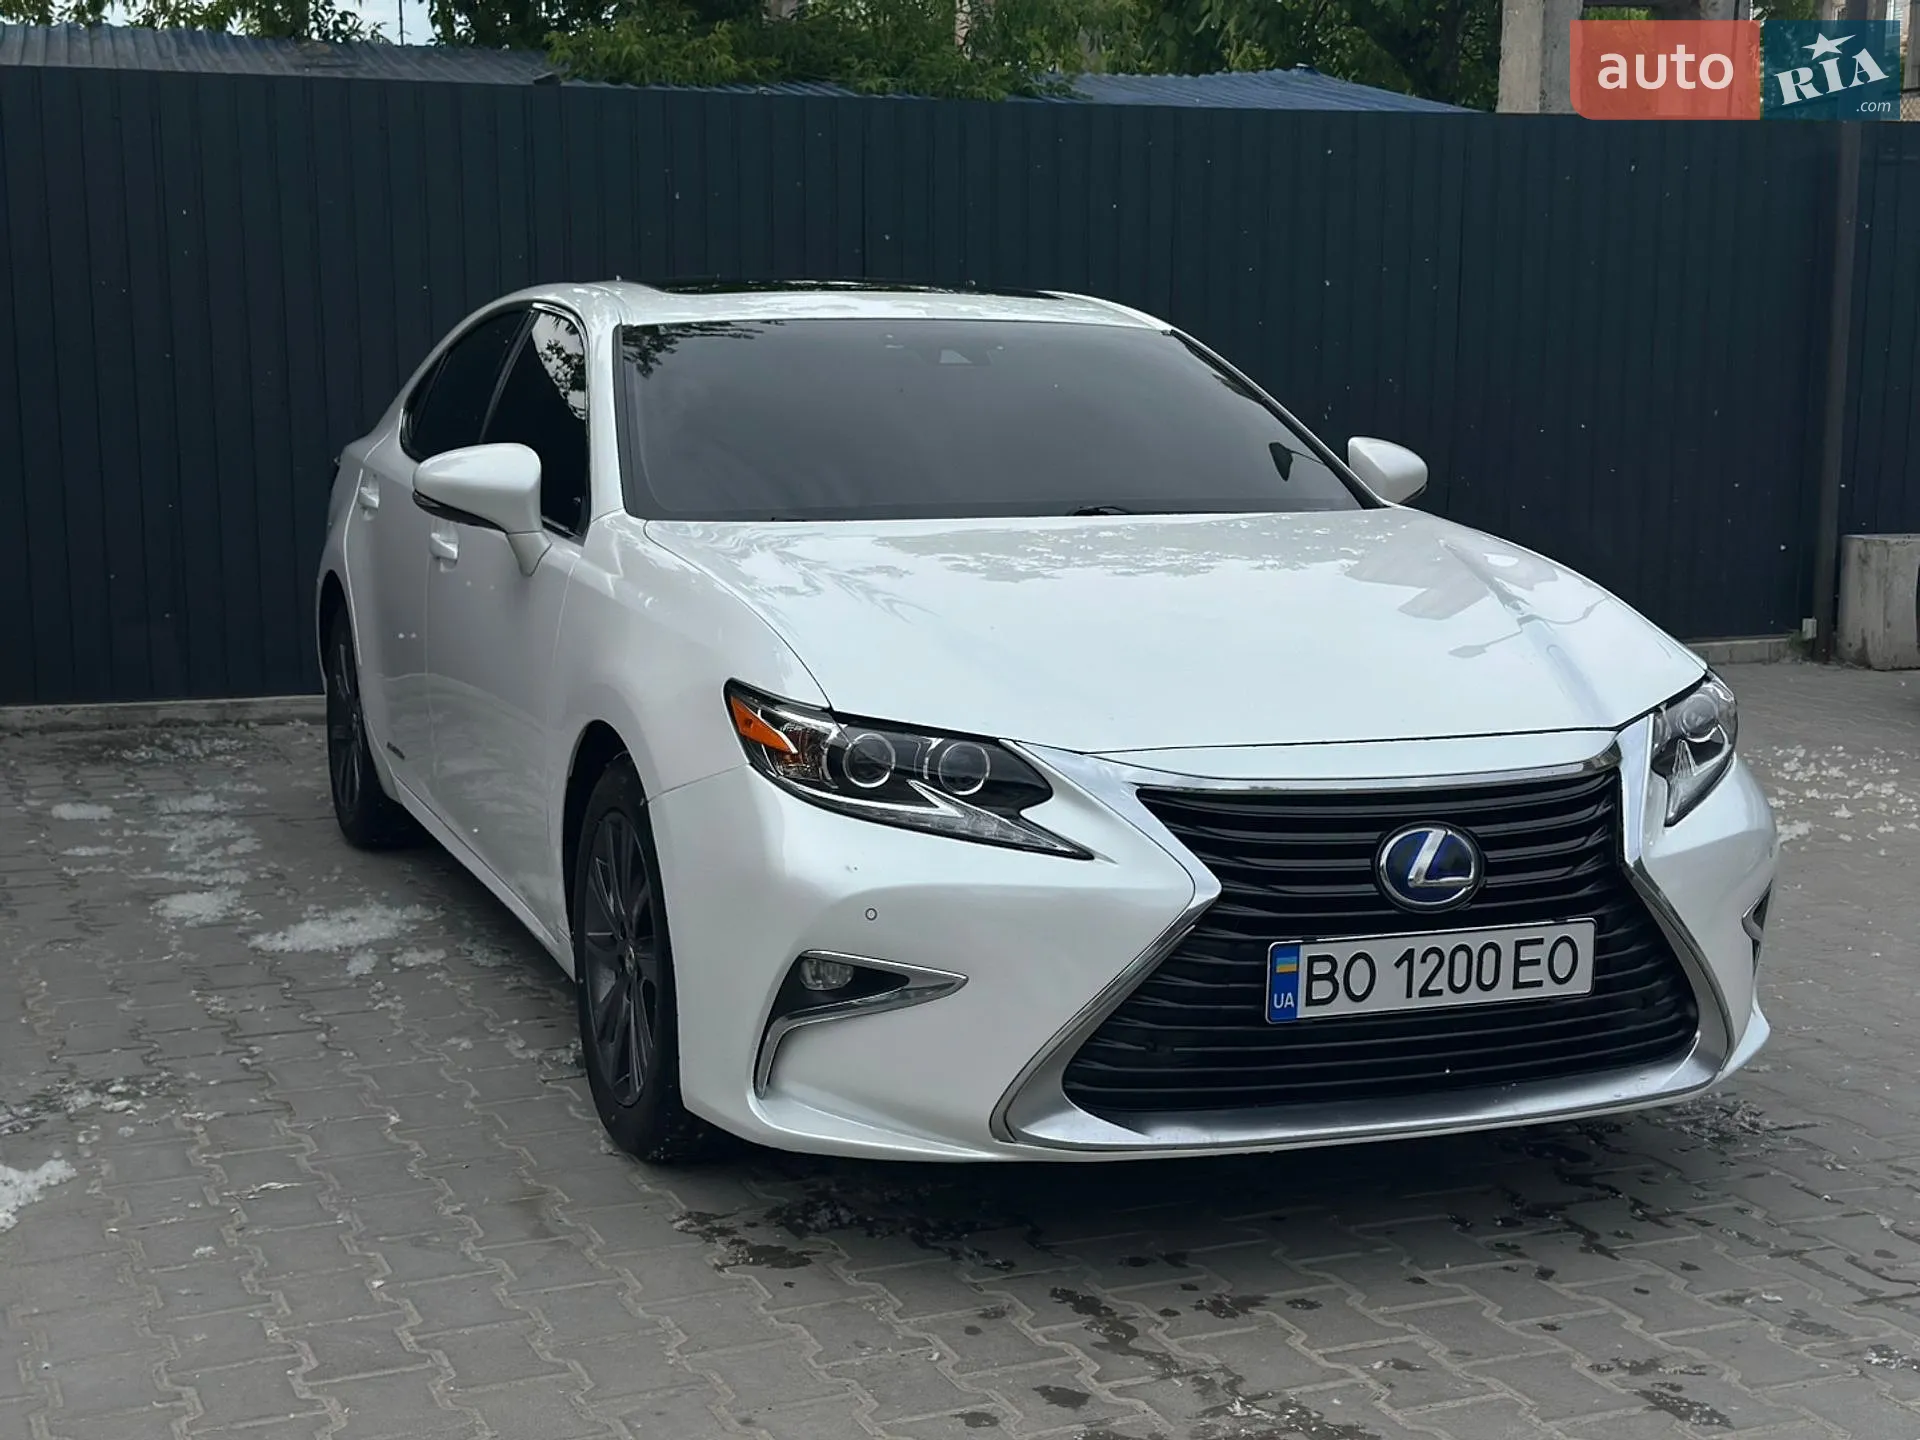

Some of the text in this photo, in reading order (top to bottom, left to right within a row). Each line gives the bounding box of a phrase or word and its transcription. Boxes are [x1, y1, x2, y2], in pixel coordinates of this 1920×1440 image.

[1305, 935, 1579, 1007] BO 1200 EO
[1273, 992, 1295, 1009] UA
